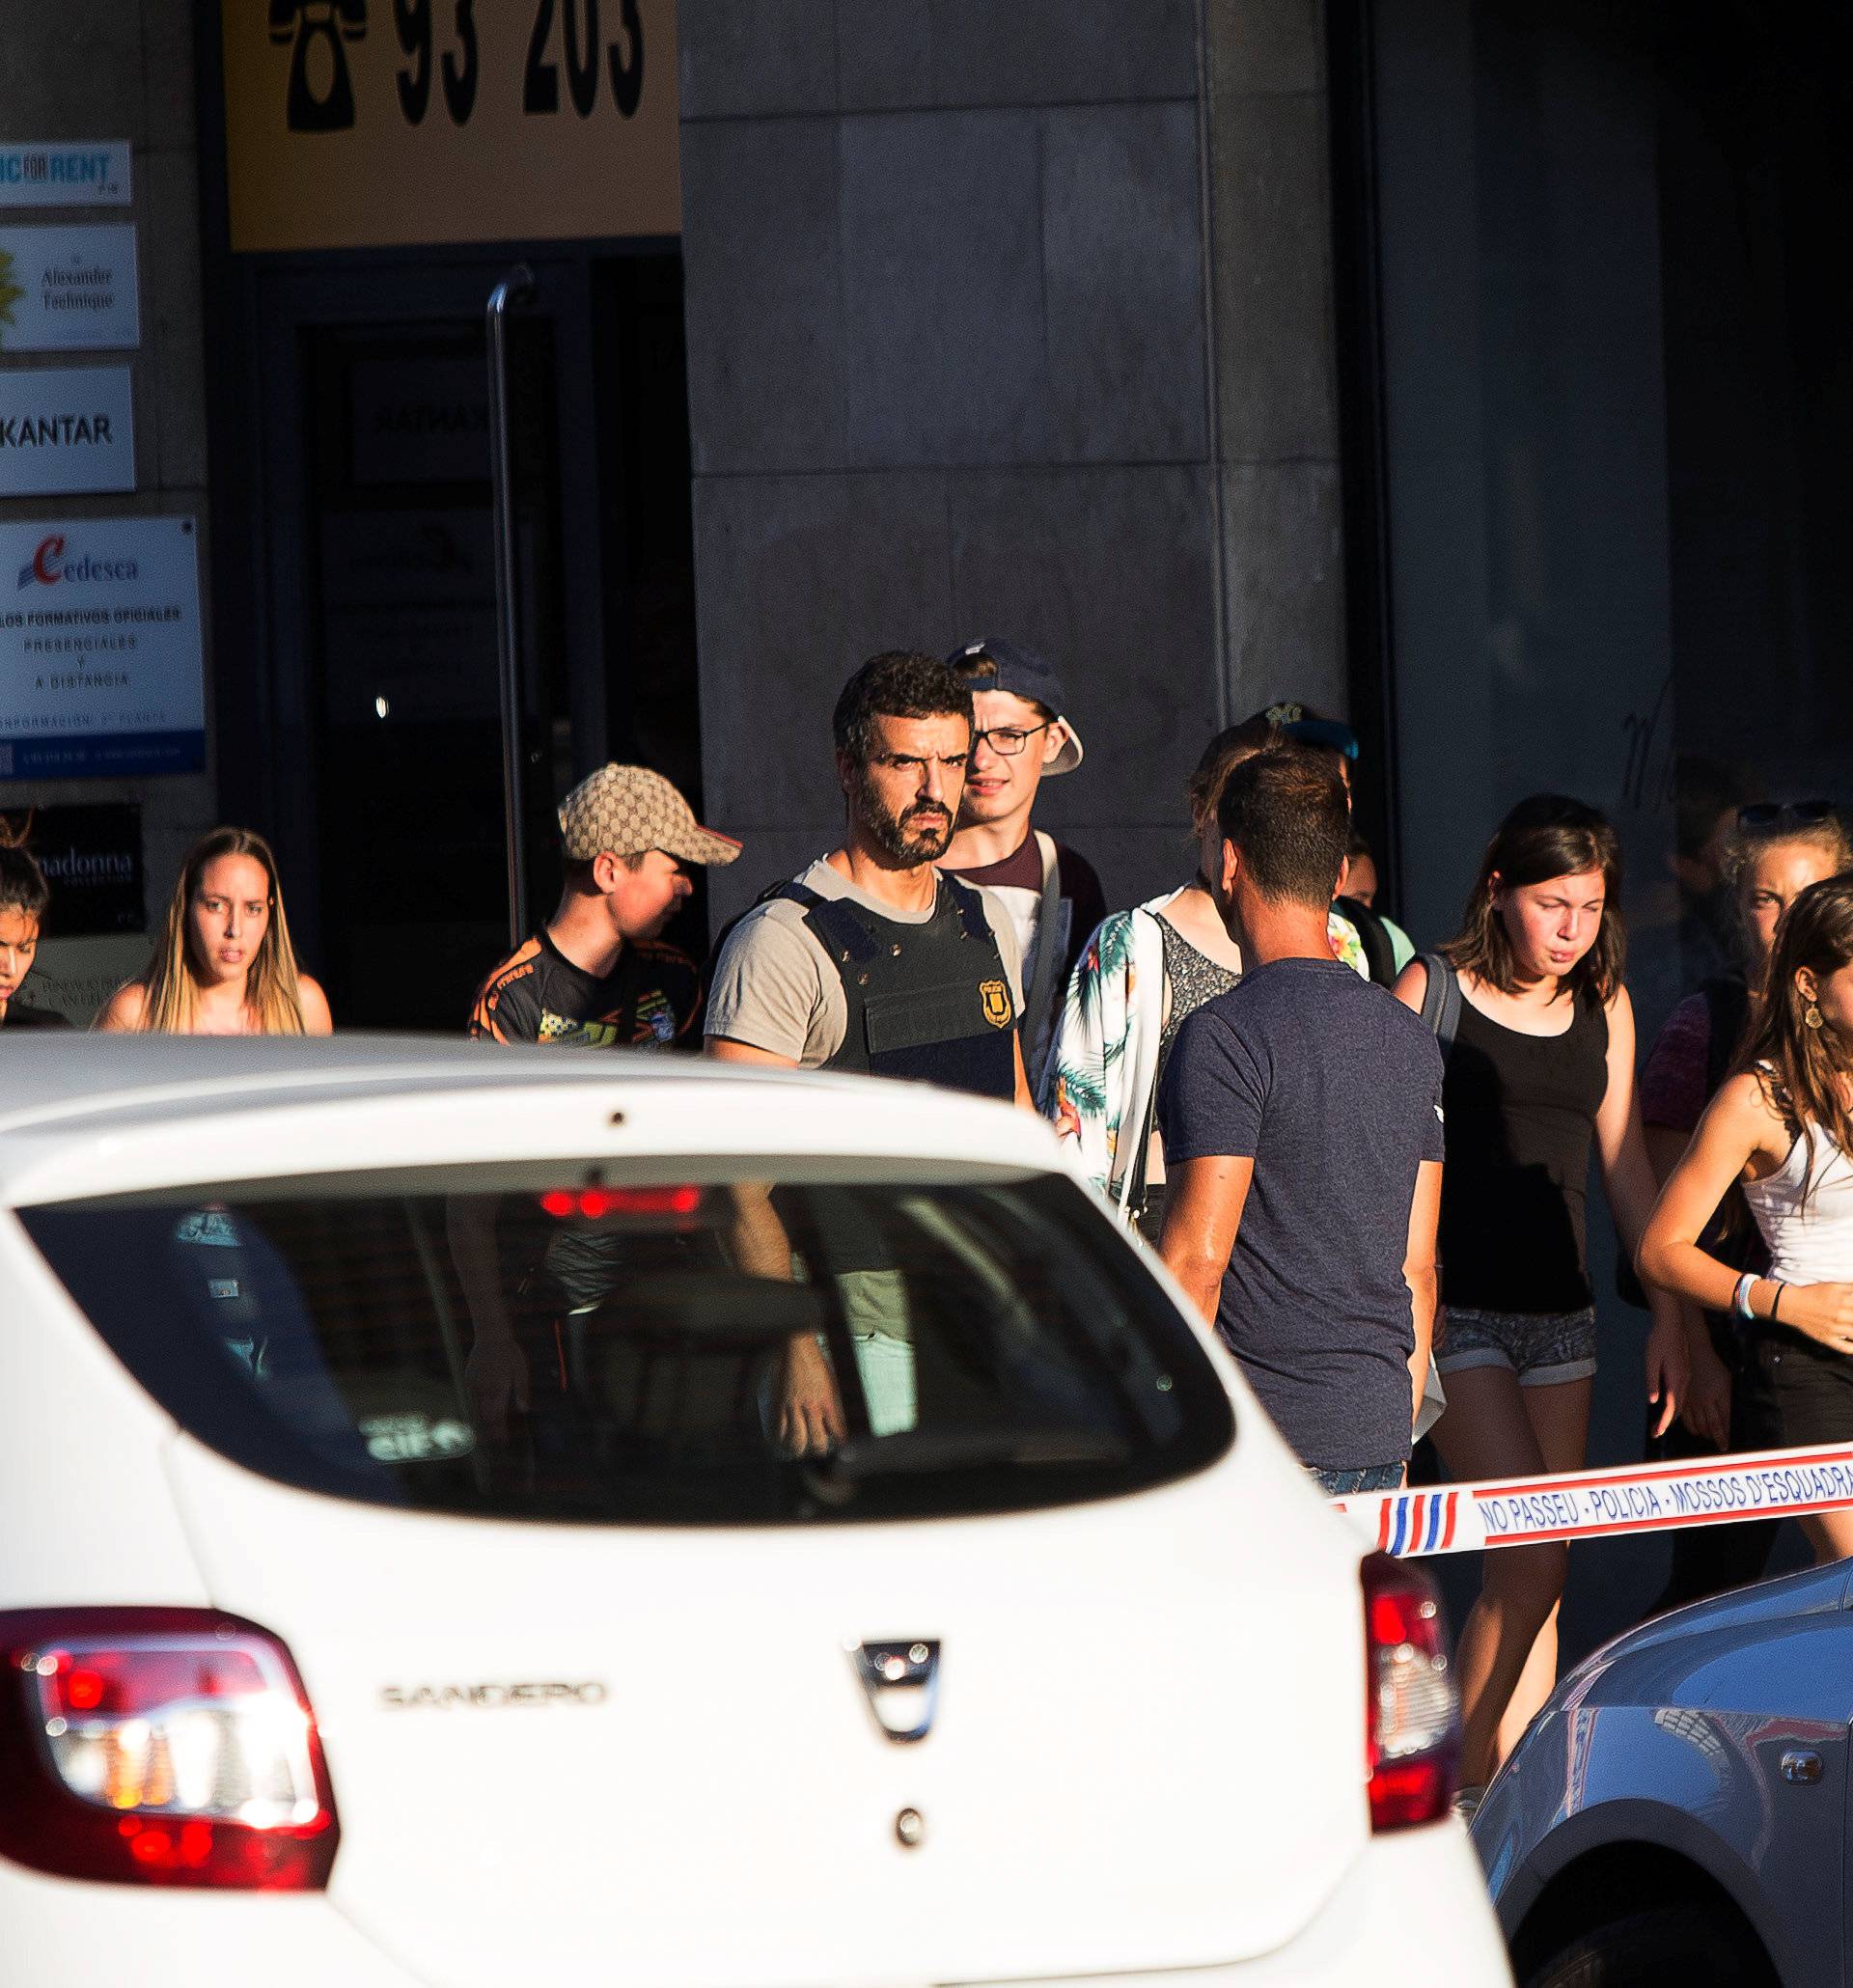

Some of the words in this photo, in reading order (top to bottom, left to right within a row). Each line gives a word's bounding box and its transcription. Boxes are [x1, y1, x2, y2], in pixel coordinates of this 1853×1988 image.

[396, 0, 477, 125] 93
[524, 0, 643, 117] 203
[50, 152, 110, 183] RENT
[41, 264, 112, 287] Alexander
[41, 290, 114, 313] Technique
[0, 415, 113, 448] KANTAR
[33, 534, 139, 585] Cedesca
[27, 609, 109, 626] FORMATIVOS
[113, 604, 180, 623] OFICIALES
[23, 633, 137, 653] PRESENCIALES
[1478, 1499, 1508, 1532] NO
[1507, 1492, 1579, 1530] PASSEU
[1588, 1484, 1662, 1523] POLICIA
[1669, 1476, 1747, 1516] MOSSOS
